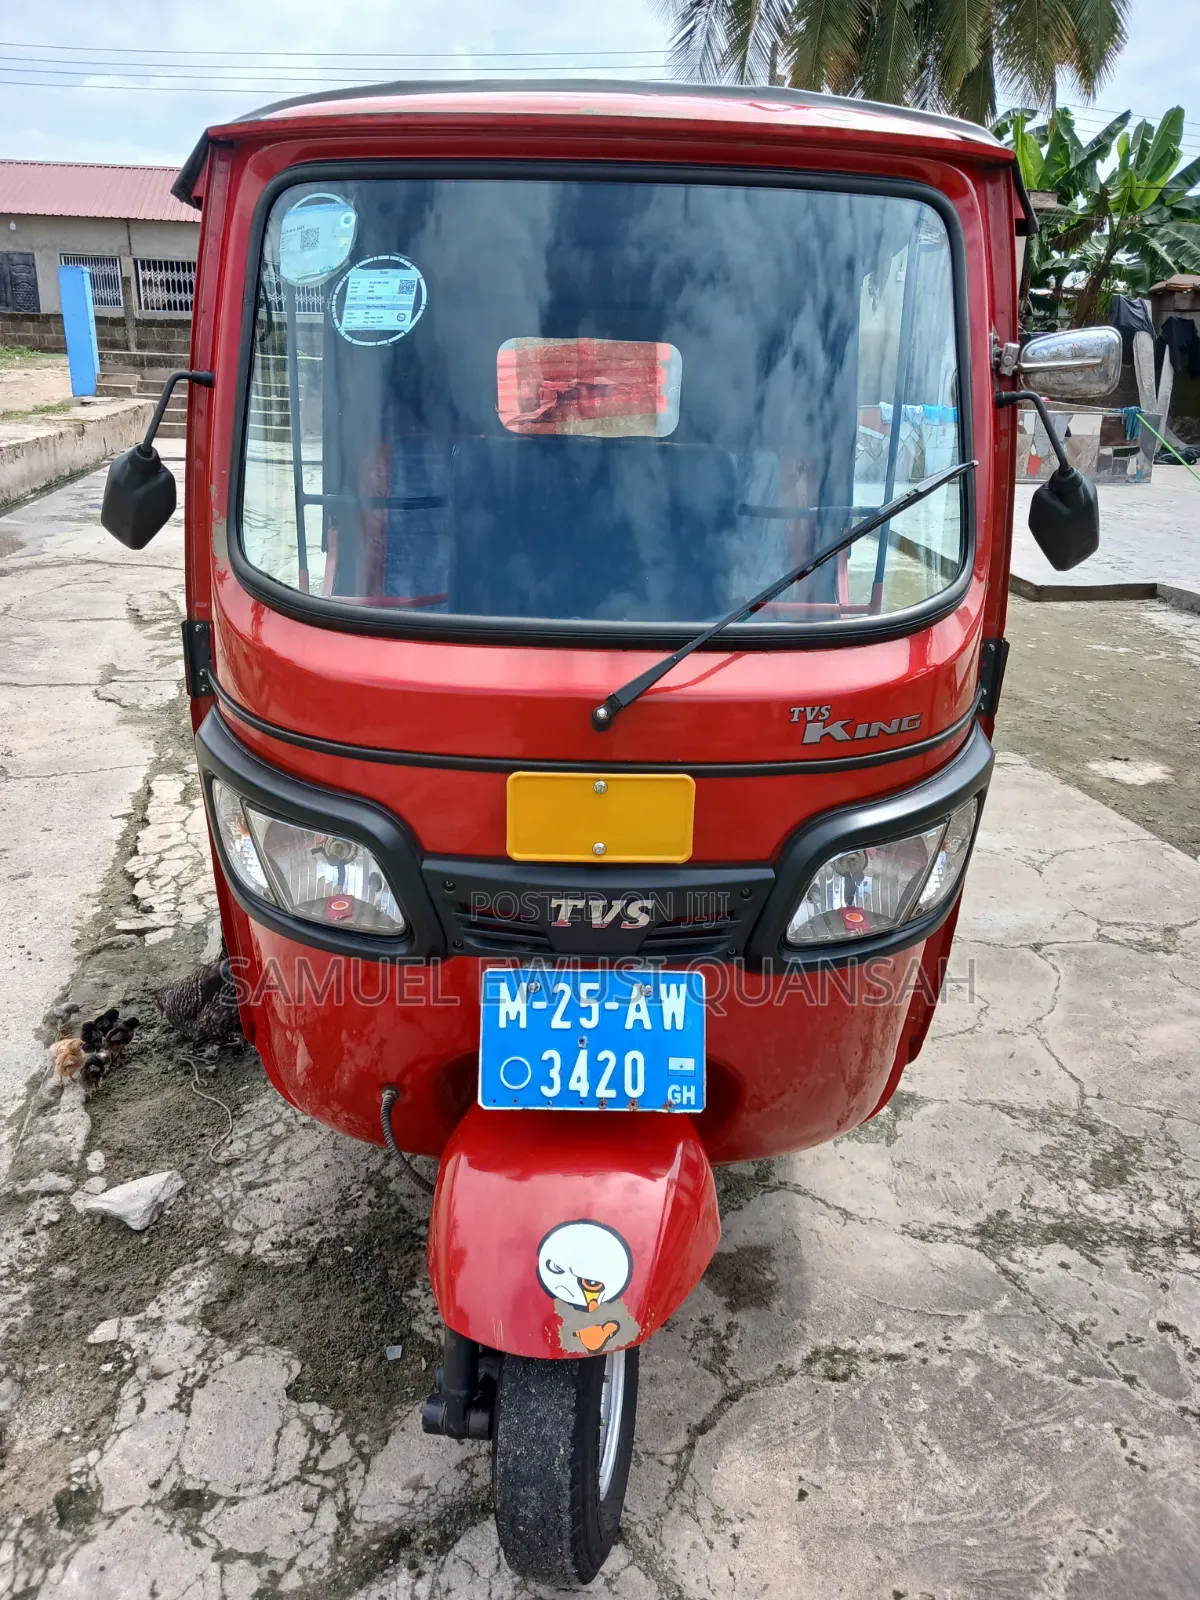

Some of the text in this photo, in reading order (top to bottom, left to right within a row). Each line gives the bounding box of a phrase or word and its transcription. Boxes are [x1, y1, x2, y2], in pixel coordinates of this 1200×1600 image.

[790, 705, 832, 722] TVS
[550, 897, 656, 929] TVS
[540, 1049, 645, 1098] 3420
[667, 1084, 696, 1105] GH
